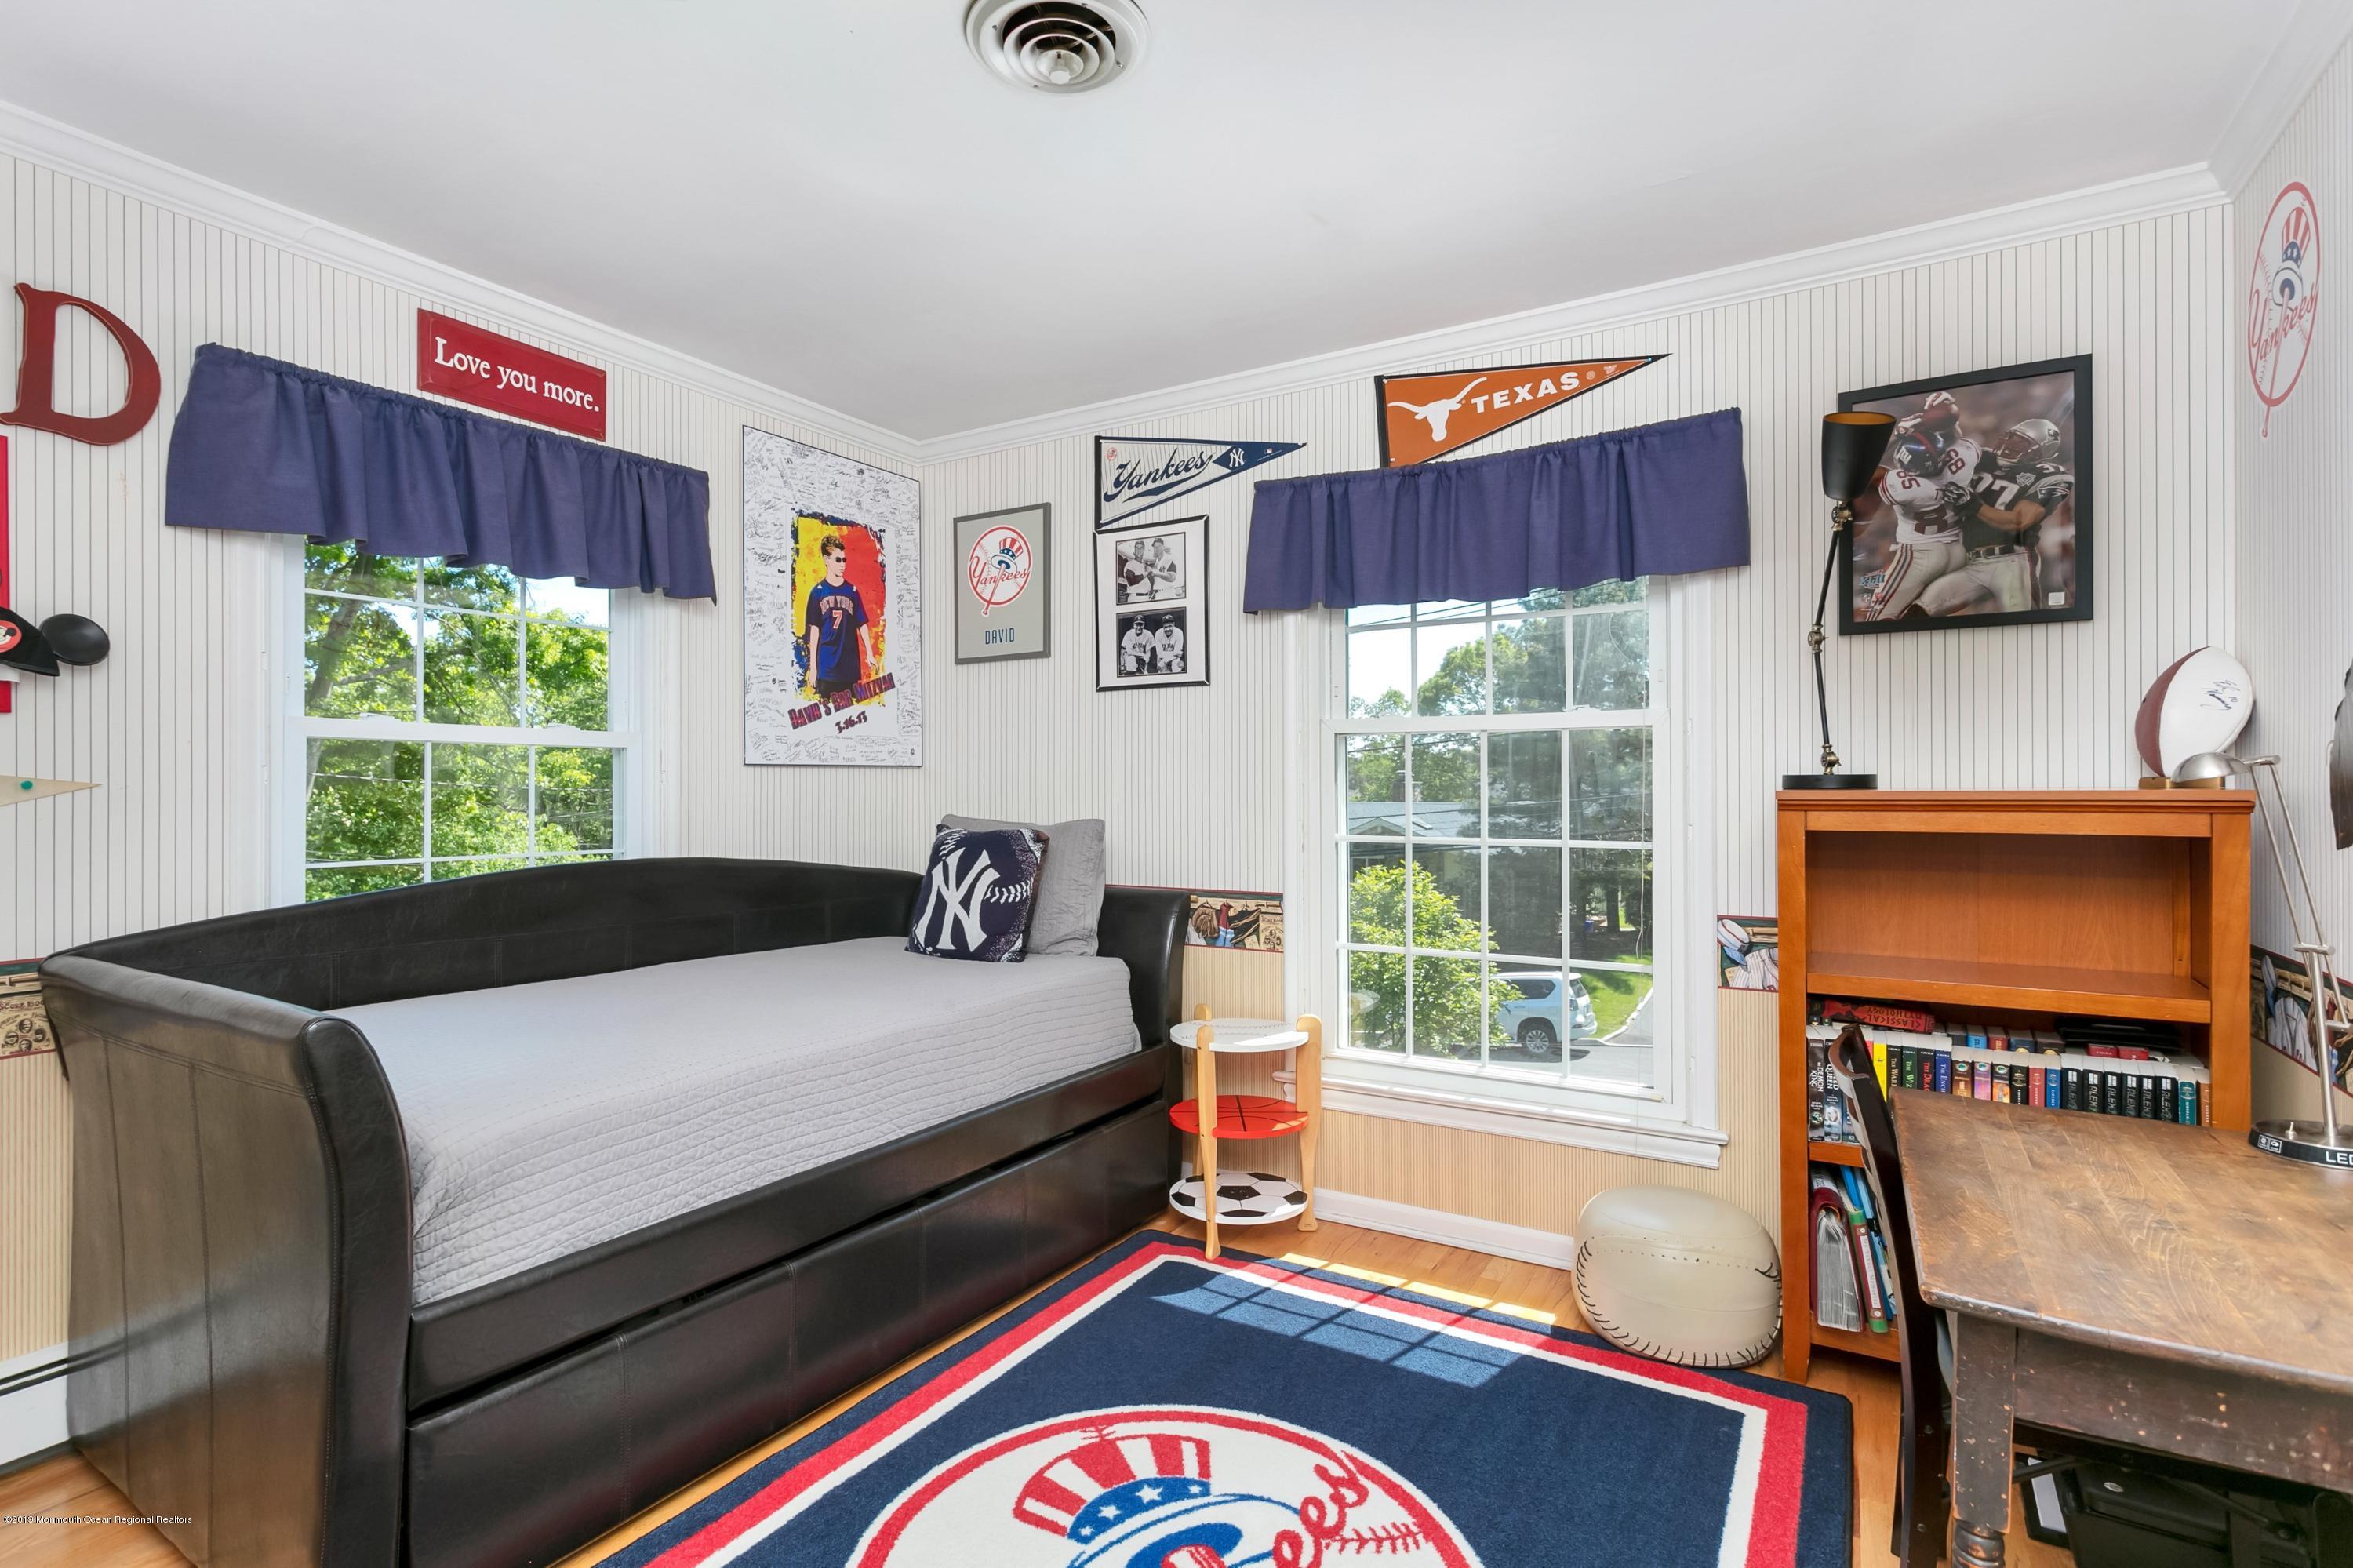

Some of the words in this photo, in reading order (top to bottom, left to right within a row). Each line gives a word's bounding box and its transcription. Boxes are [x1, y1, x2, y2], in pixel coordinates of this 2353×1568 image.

[2249, 282, 2315, 377] Yankees
[0, 282, 161, 446] D
[434, 336, 491, 378] Love
[497, 365, 538, 394] you
[543, 380, 600, 412] more.
[1471, 372, 1580, 413] TEXAS
[1104, 448, 1213, 503] Yankees
[970, 555, 1028, 590] Yankees
[820, 595, 835, 615] NEW
[835, 595, 854, 616] YORK
[832, 609, 843, 629] 7
[985, 628, 1015, 645] DAVID
[787, 697, 831, 730] DAVID'S
[831, 689, 854, 712] BAR
[853, 672, 896, 703] MITZVAH
[915, 847, 1000, 952] NY
